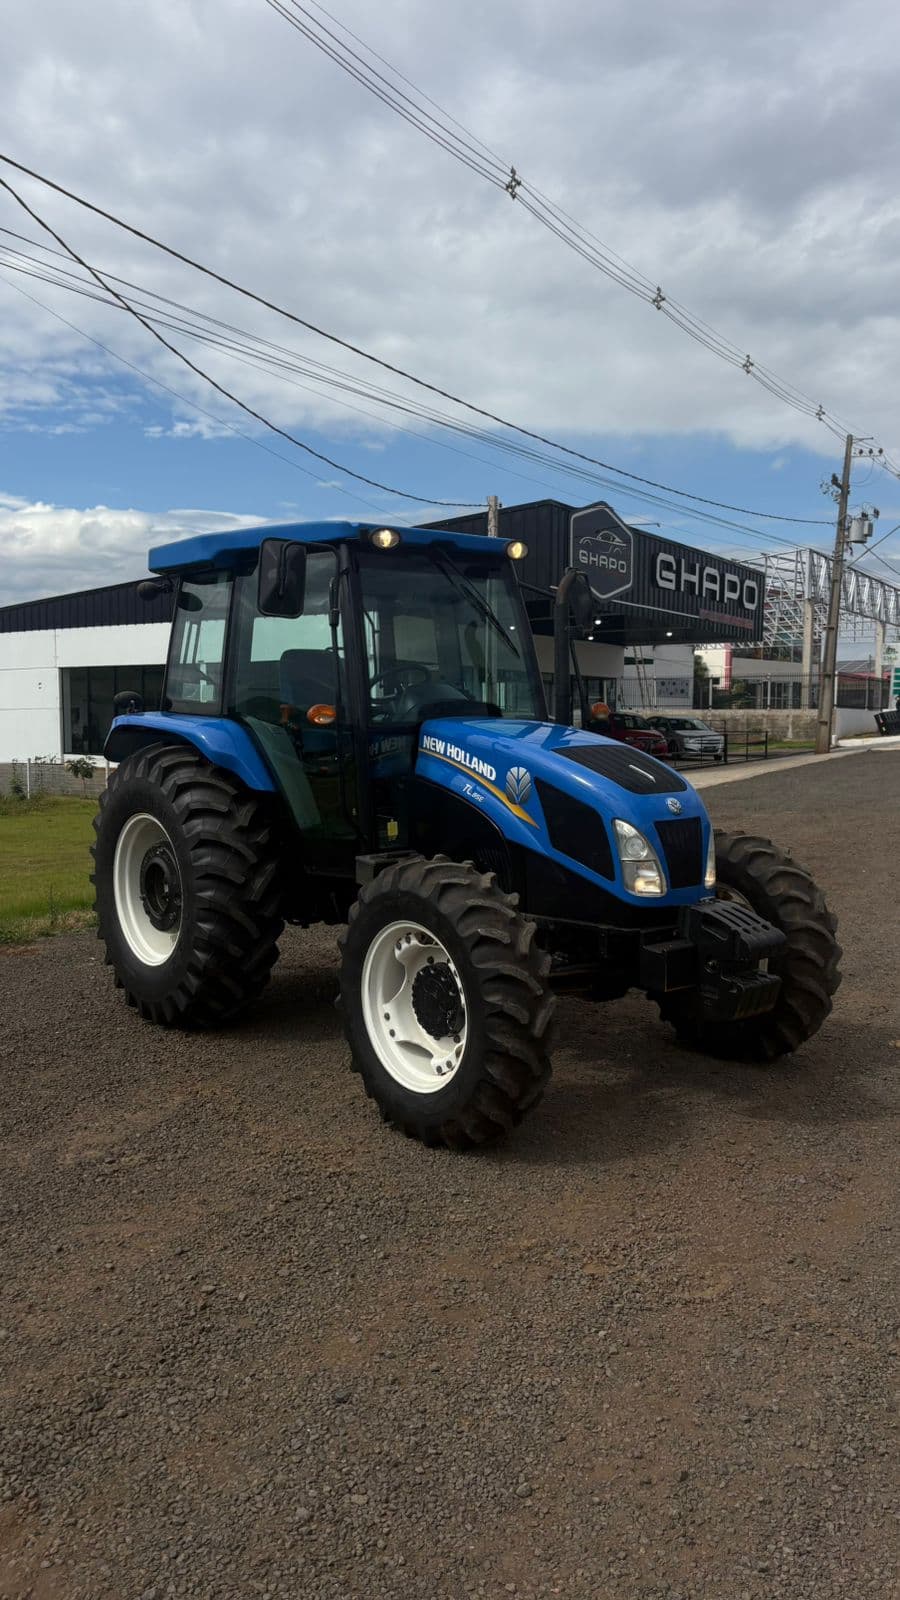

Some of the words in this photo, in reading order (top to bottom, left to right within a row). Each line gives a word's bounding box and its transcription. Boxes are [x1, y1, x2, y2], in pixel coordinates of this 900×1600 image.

[579, 550, 627, 573] GHAPO
[656, 552, 758, 610] GHAPO
[422, 735, 445, 755] NEW
[446, 742, 497, 781] HOLLAND
